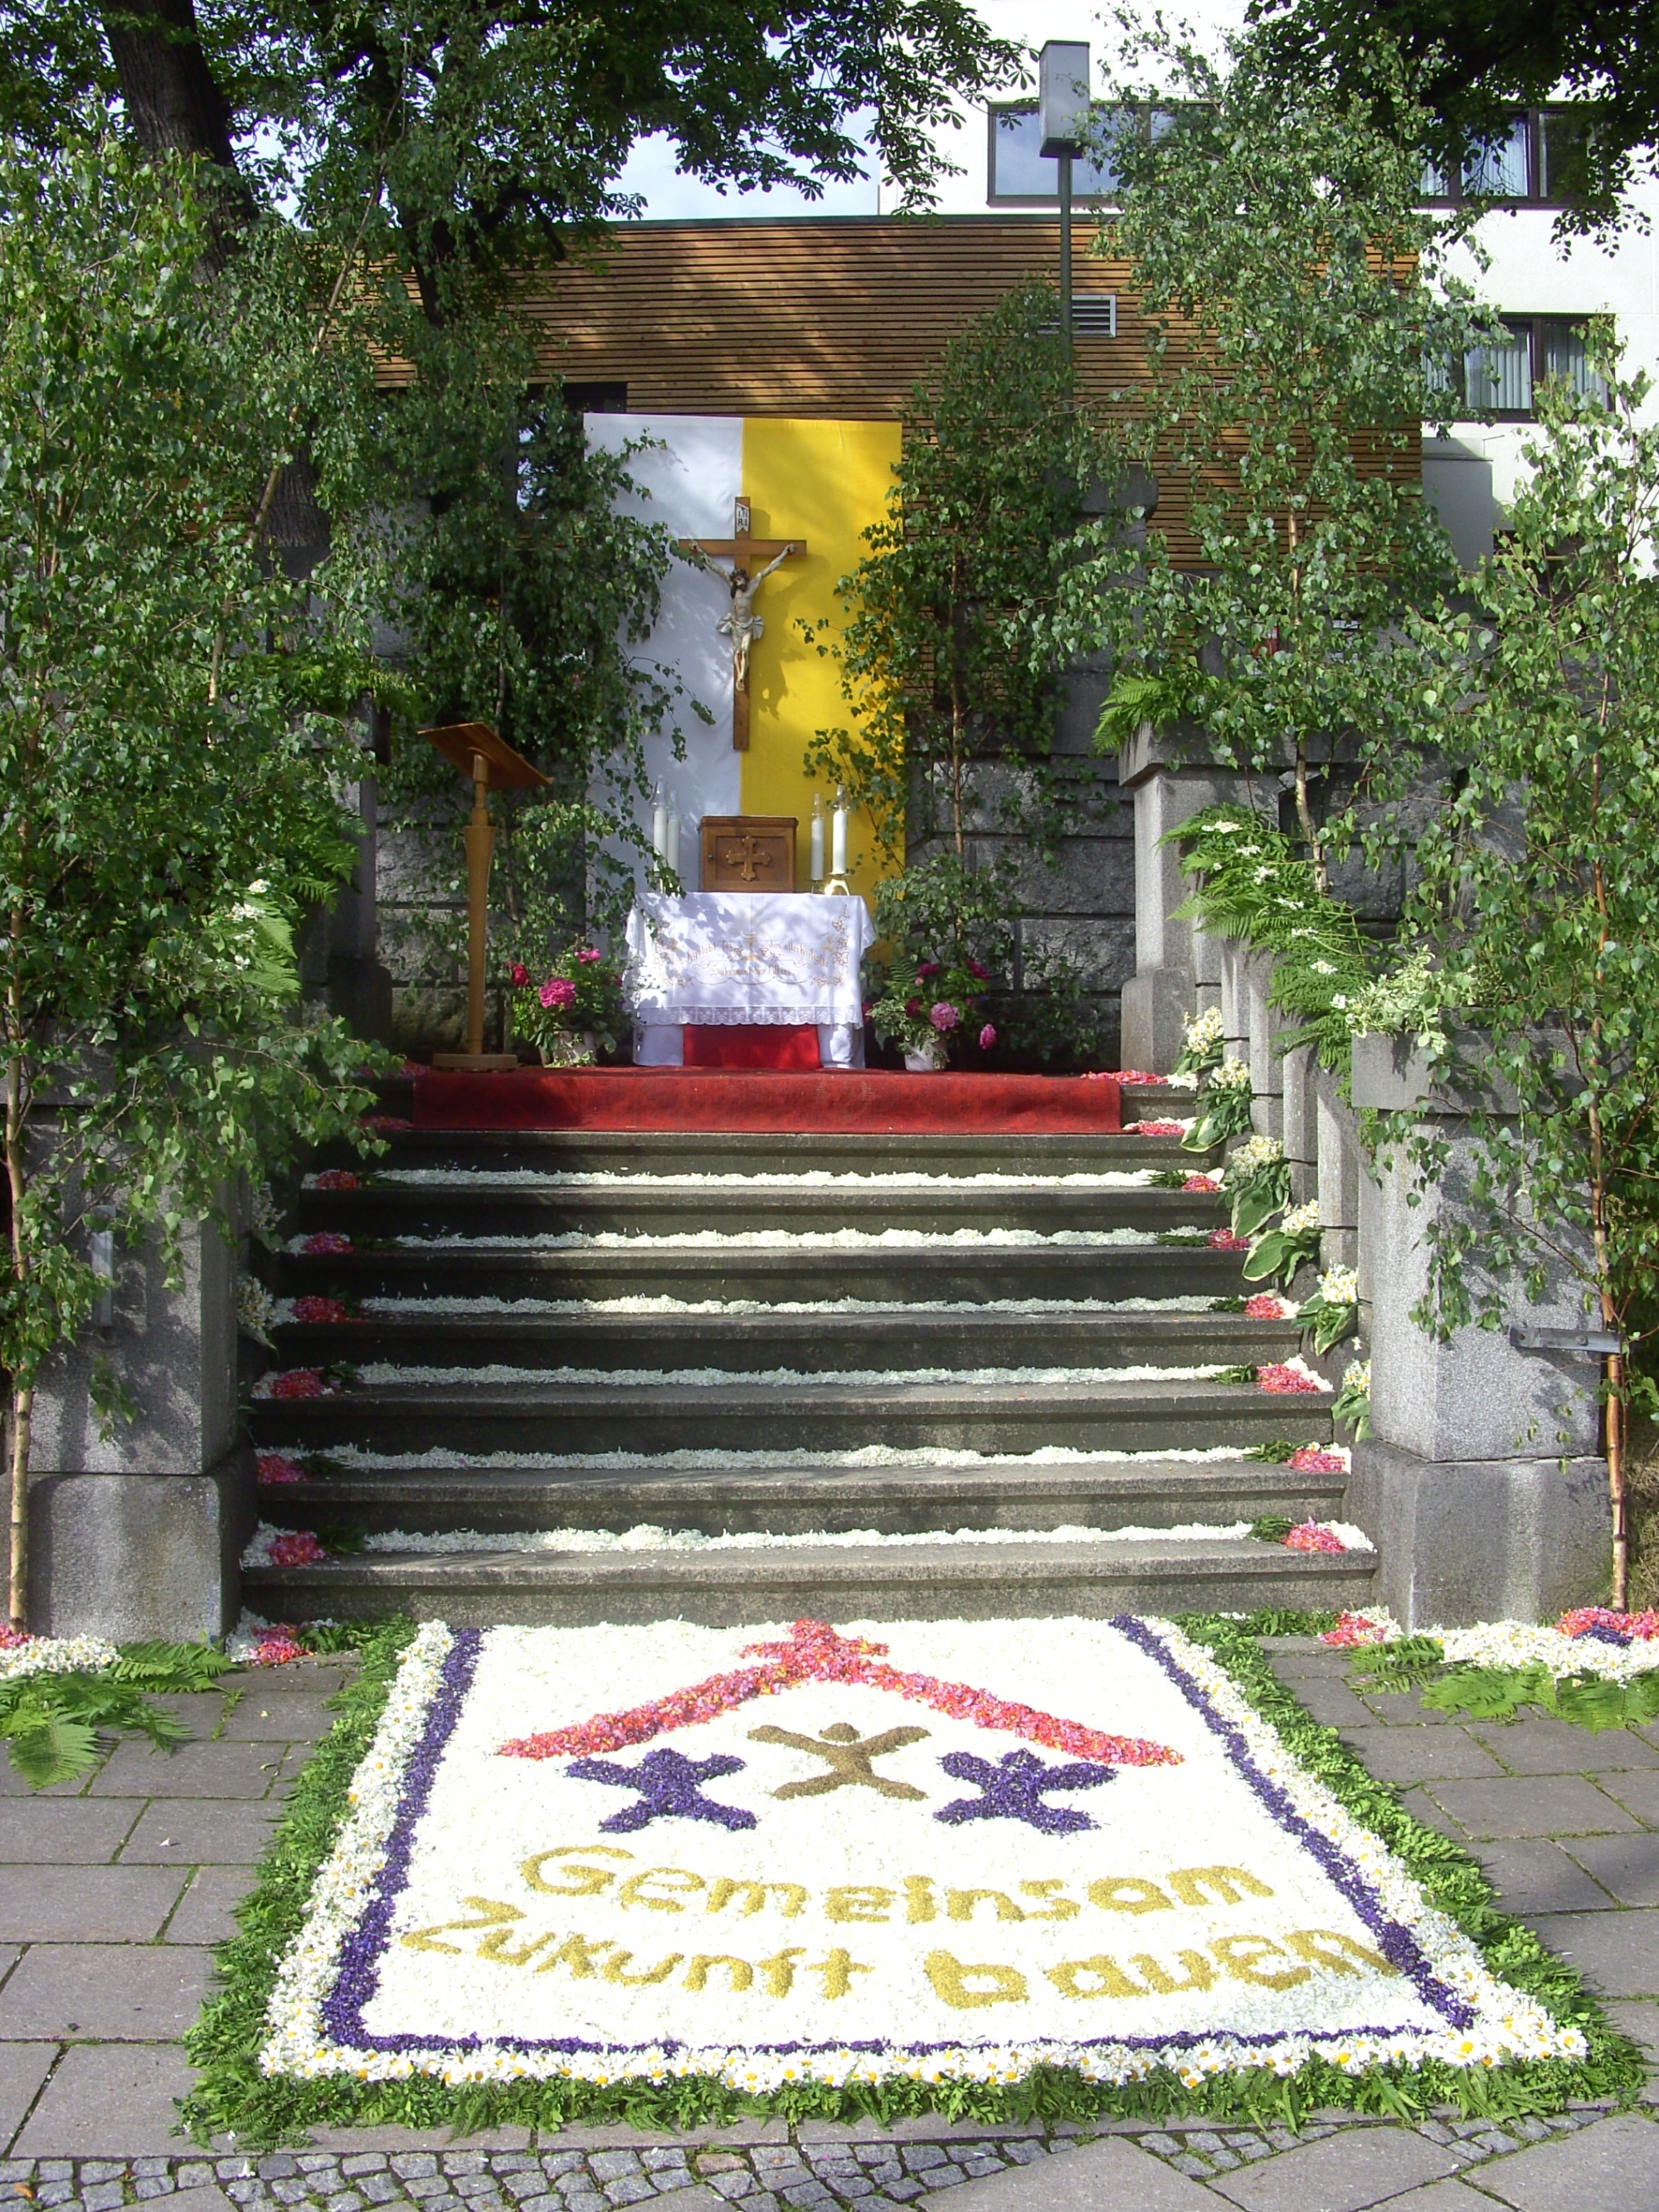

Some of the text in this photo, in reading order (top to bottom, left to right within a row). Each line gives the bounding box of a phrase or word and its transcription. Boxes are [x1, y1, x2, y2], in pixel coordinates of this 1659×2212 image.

[520, 1845, 1273, 1922] Gemeinsam
[401, 1895, 1399, 2010] Zukunft bauen
